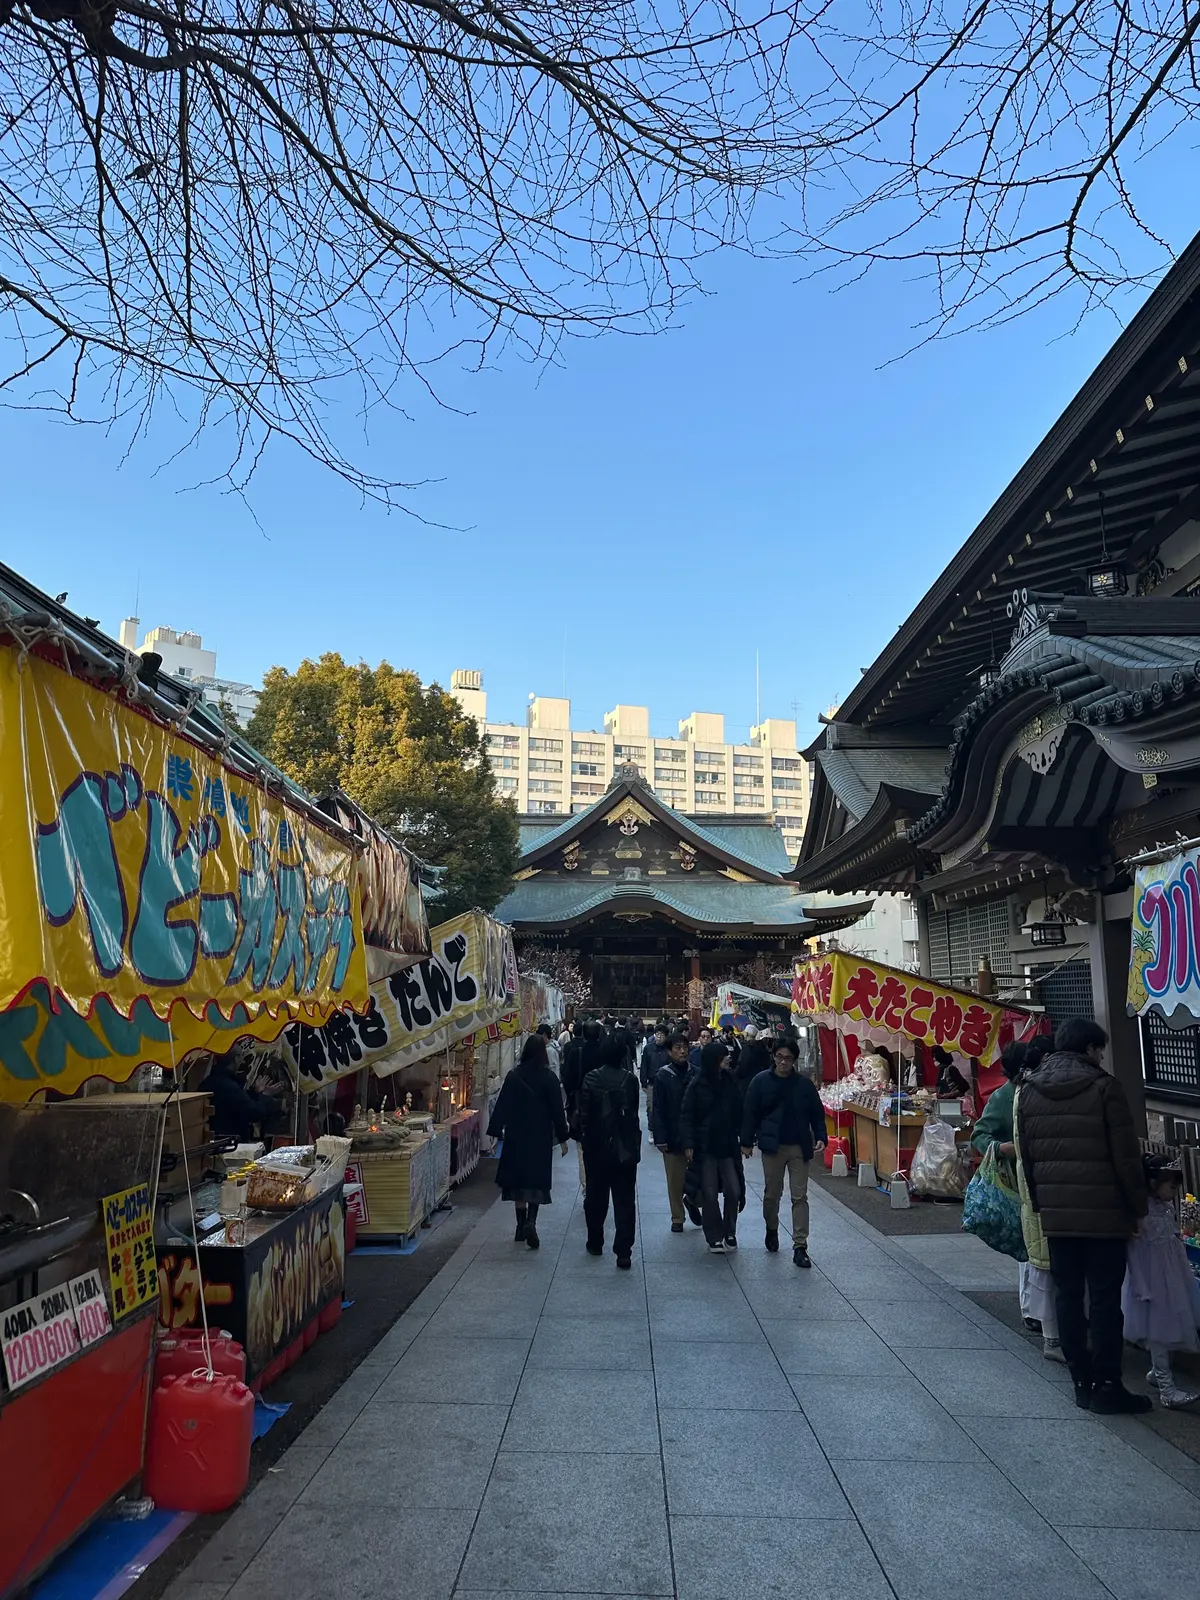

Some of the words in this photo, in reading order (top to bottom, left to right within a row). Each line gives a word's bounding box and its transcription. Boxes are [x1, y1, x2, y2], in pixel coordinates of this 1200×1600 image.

[38, 763, 356, 994] ベビーカステラ
[389, 932, 479, 1033] だんご
[843, 967, 993, 1057] 大たこやき
[74, 1276, 101, 1305] 12個入
[111, 1253, 126, 1313] 牛乳
[122, 1247, 136, 1307] さとう
[133, 1242, 148, 1300] ハチミツ
[144, 1235, 158, 1294] 玉子
[4, 1307, 37, 1340] 40個入
[41, 1291, 69, 1321] 20個入
